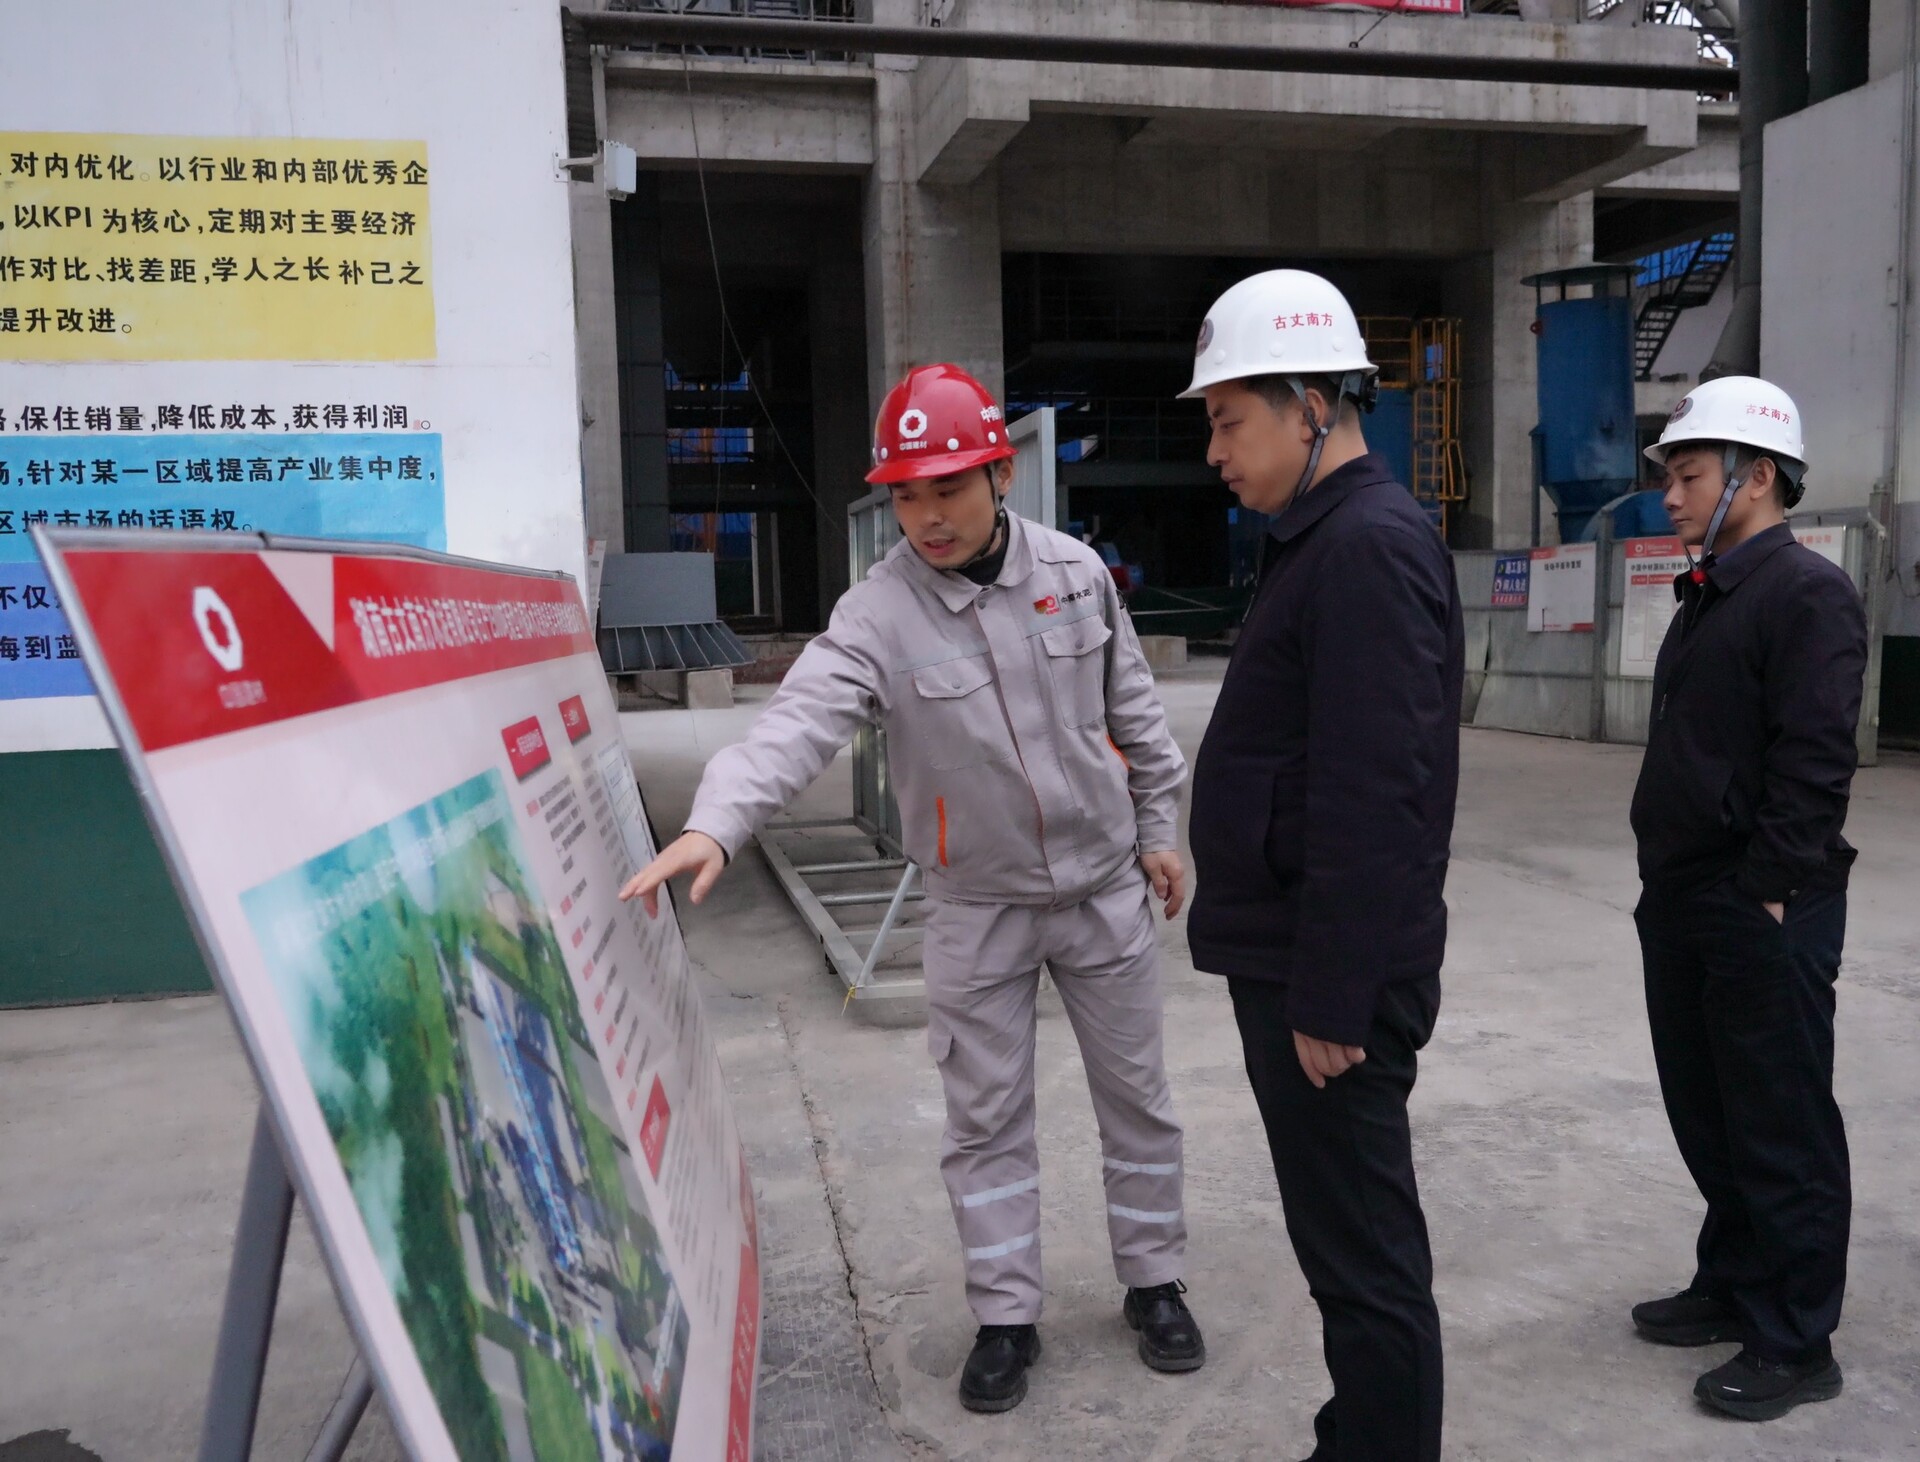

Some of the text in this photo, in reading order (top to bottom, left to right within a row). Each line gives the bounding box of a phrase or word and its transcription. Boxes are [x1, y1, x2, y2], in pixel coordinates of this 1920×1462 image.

[1272, 312, 1333, 330] 古丈南方
[1745, 403, 1791, 424] 古丈南方
[0, 585, 62, 611] 不仅
